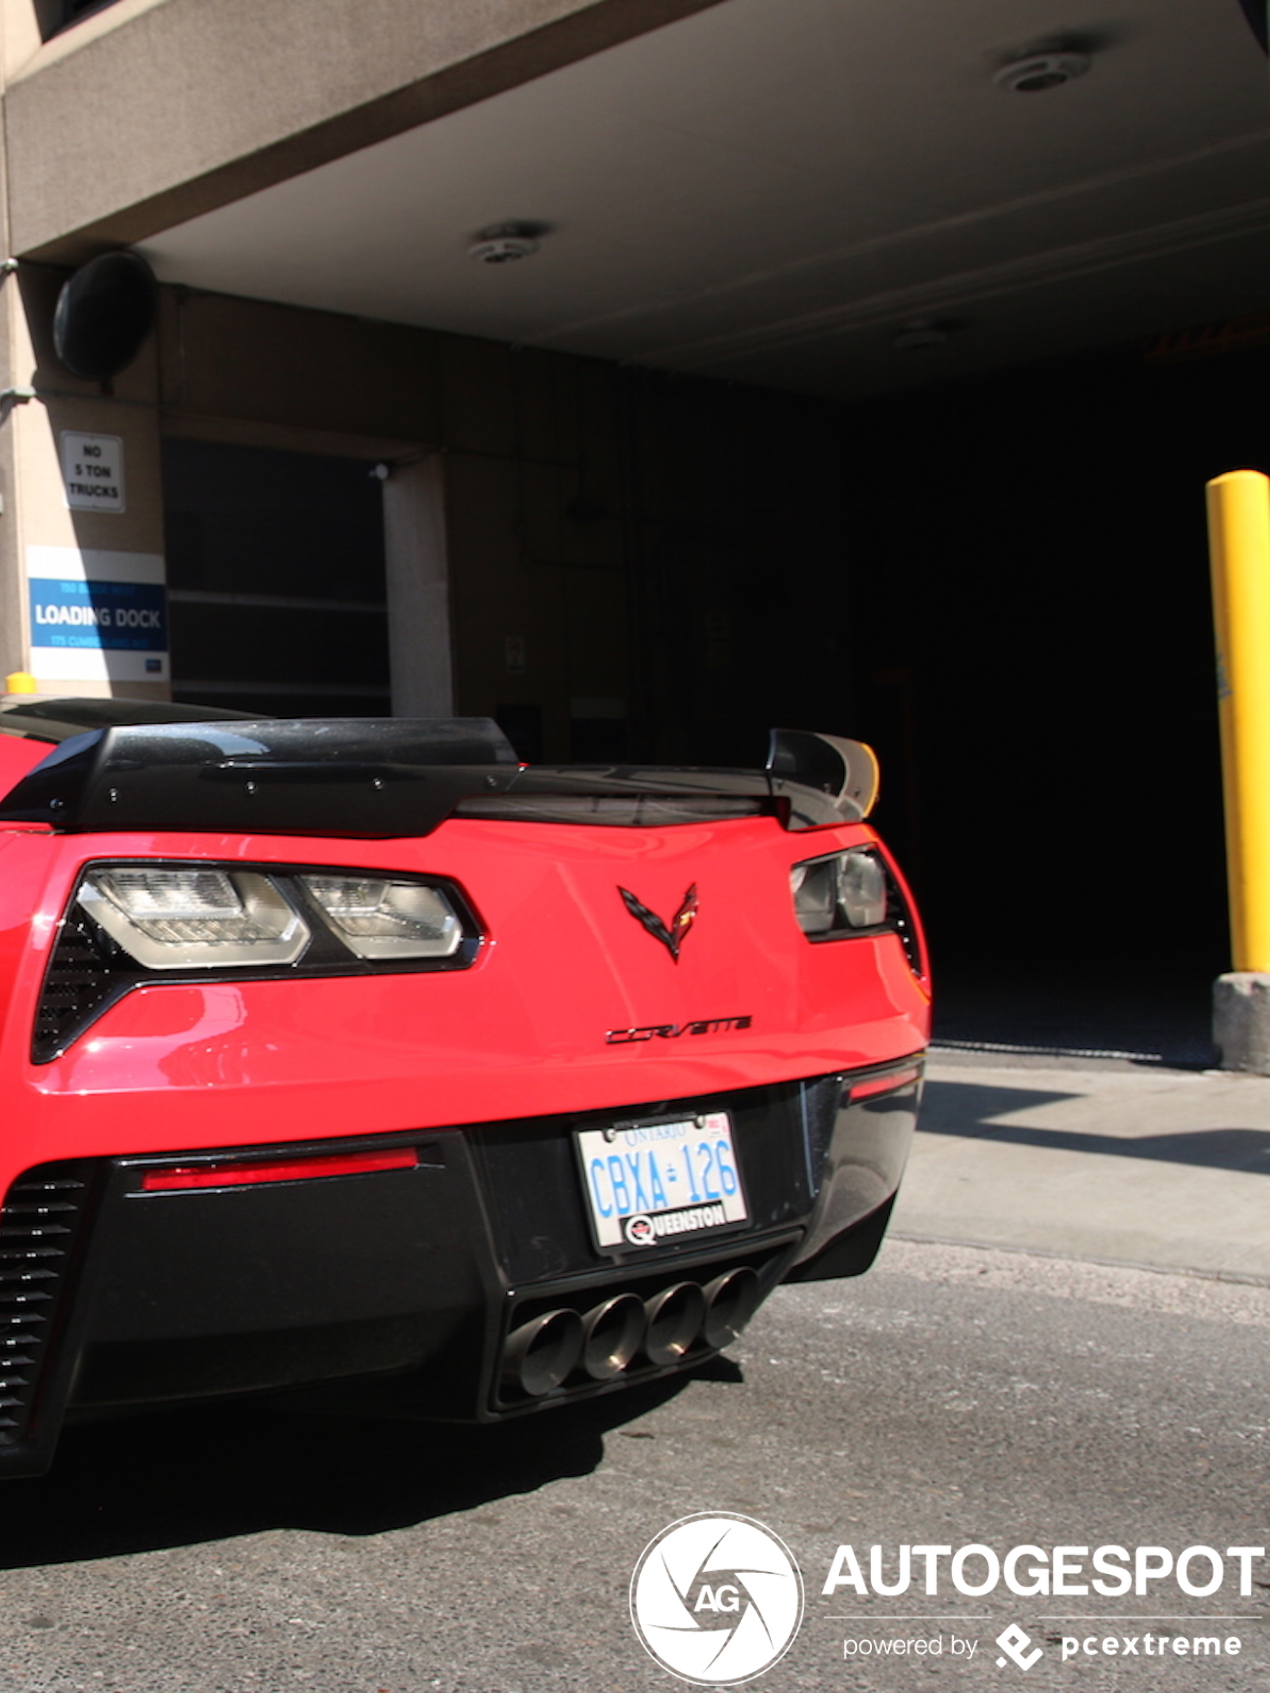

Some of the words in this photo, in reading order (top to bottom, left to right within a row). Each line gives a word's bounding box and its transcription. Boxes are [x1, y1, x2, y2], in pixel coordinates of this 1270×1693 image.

[83, 445, 101, 458] NO
[75, 465, 82, 476] 5
[87, 466, 111, 479] TON
[69, 483, 119, 499] TRUCKS
[35, 604, 111, 626] LOADING
[116, 609, 161, 628] DOCK
[605, 1015, 753, 1044] CORVETTE
[590, 1149, 669, 1218] CBXA
[682, 1140, 737, 1203] 126
[626, 1205, 726, 1246] QUEENSTON
